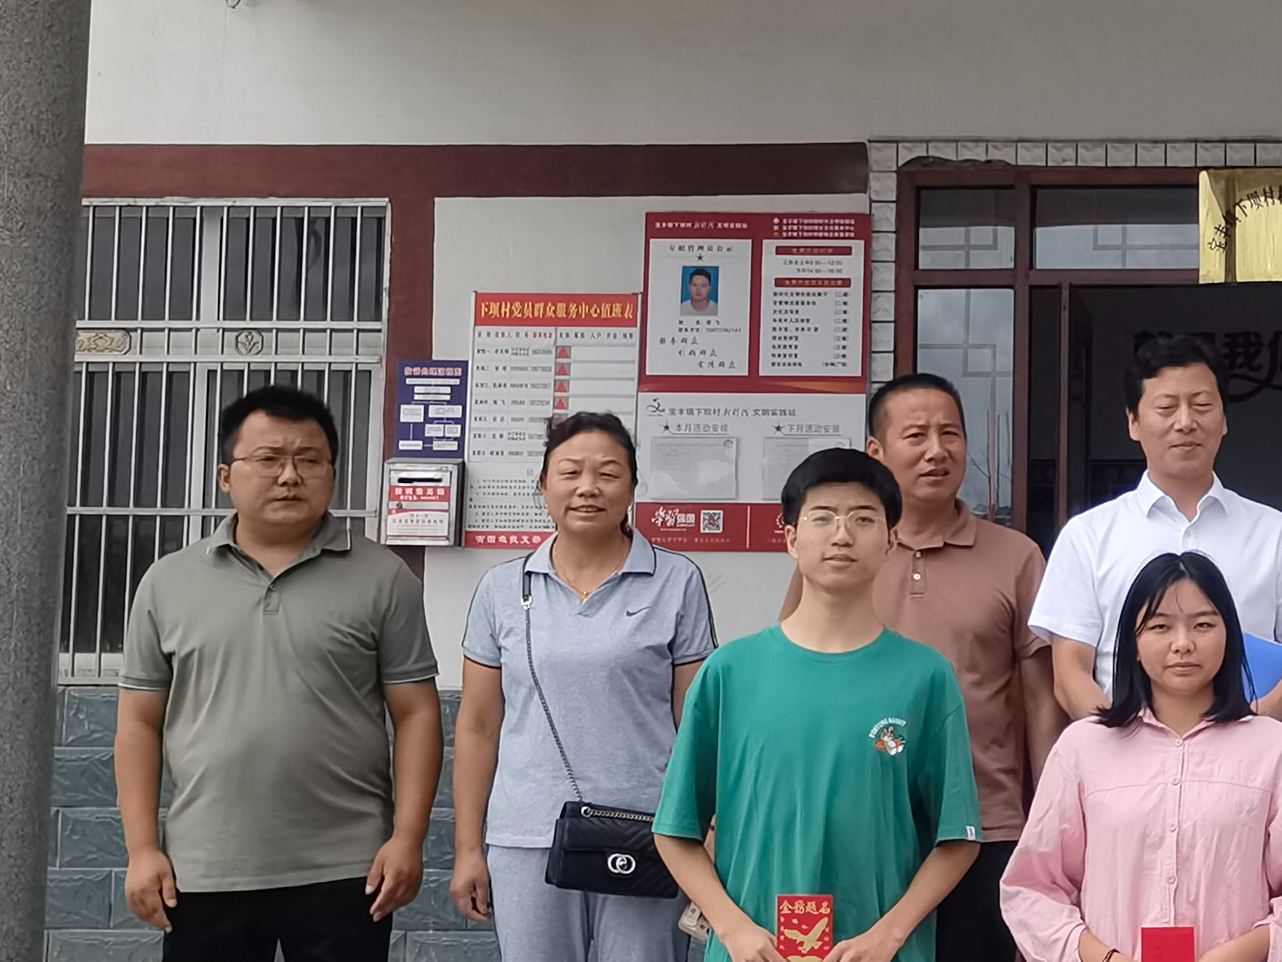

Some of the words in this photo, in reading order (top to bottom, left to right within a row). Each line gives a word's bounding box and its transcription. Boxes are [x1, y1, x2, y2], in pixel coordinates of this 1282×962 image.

[481, 302, 634, 319] 下坝村党员群众服务中心值班表
